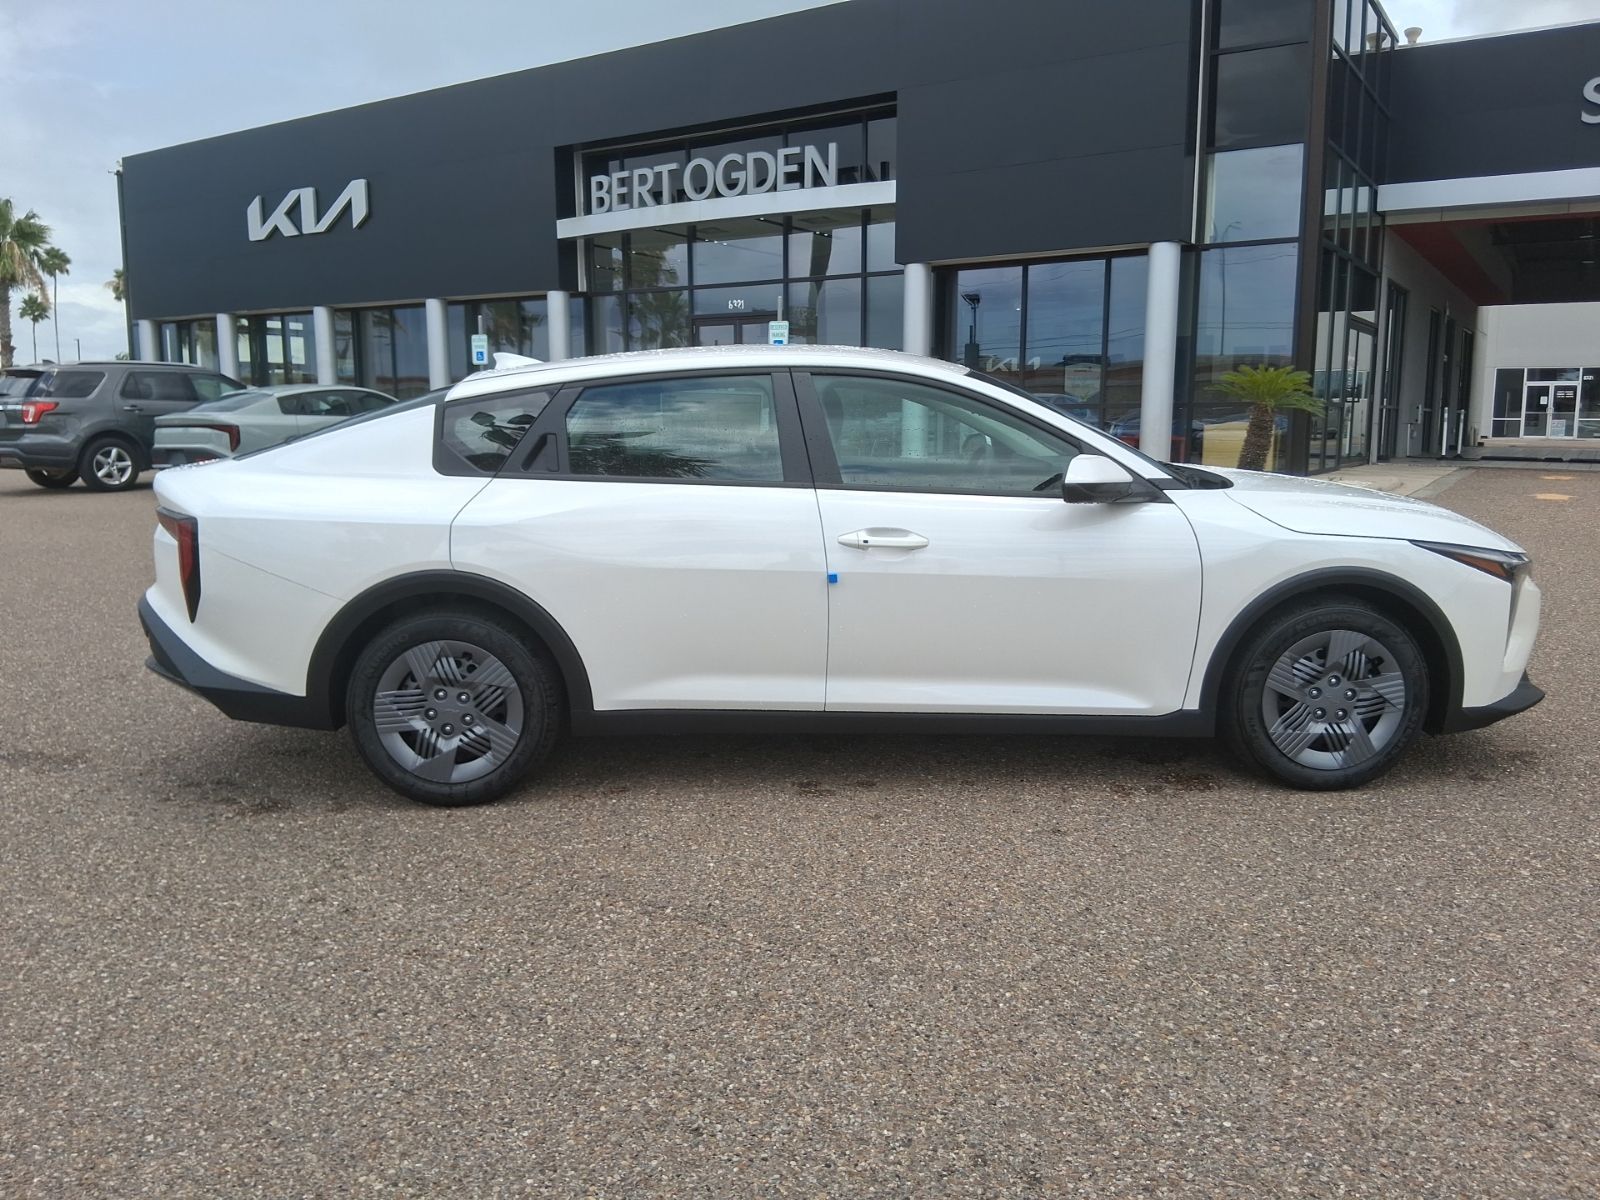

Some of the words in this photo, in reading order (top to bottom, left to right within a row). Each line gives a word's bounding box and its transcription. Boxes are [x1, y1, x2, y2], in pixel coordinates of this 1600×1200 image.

[247, 178, 369, 241] KIA
[590, 162, 680, 214] BERT
[683, 142, 838, 201] OGDEN
